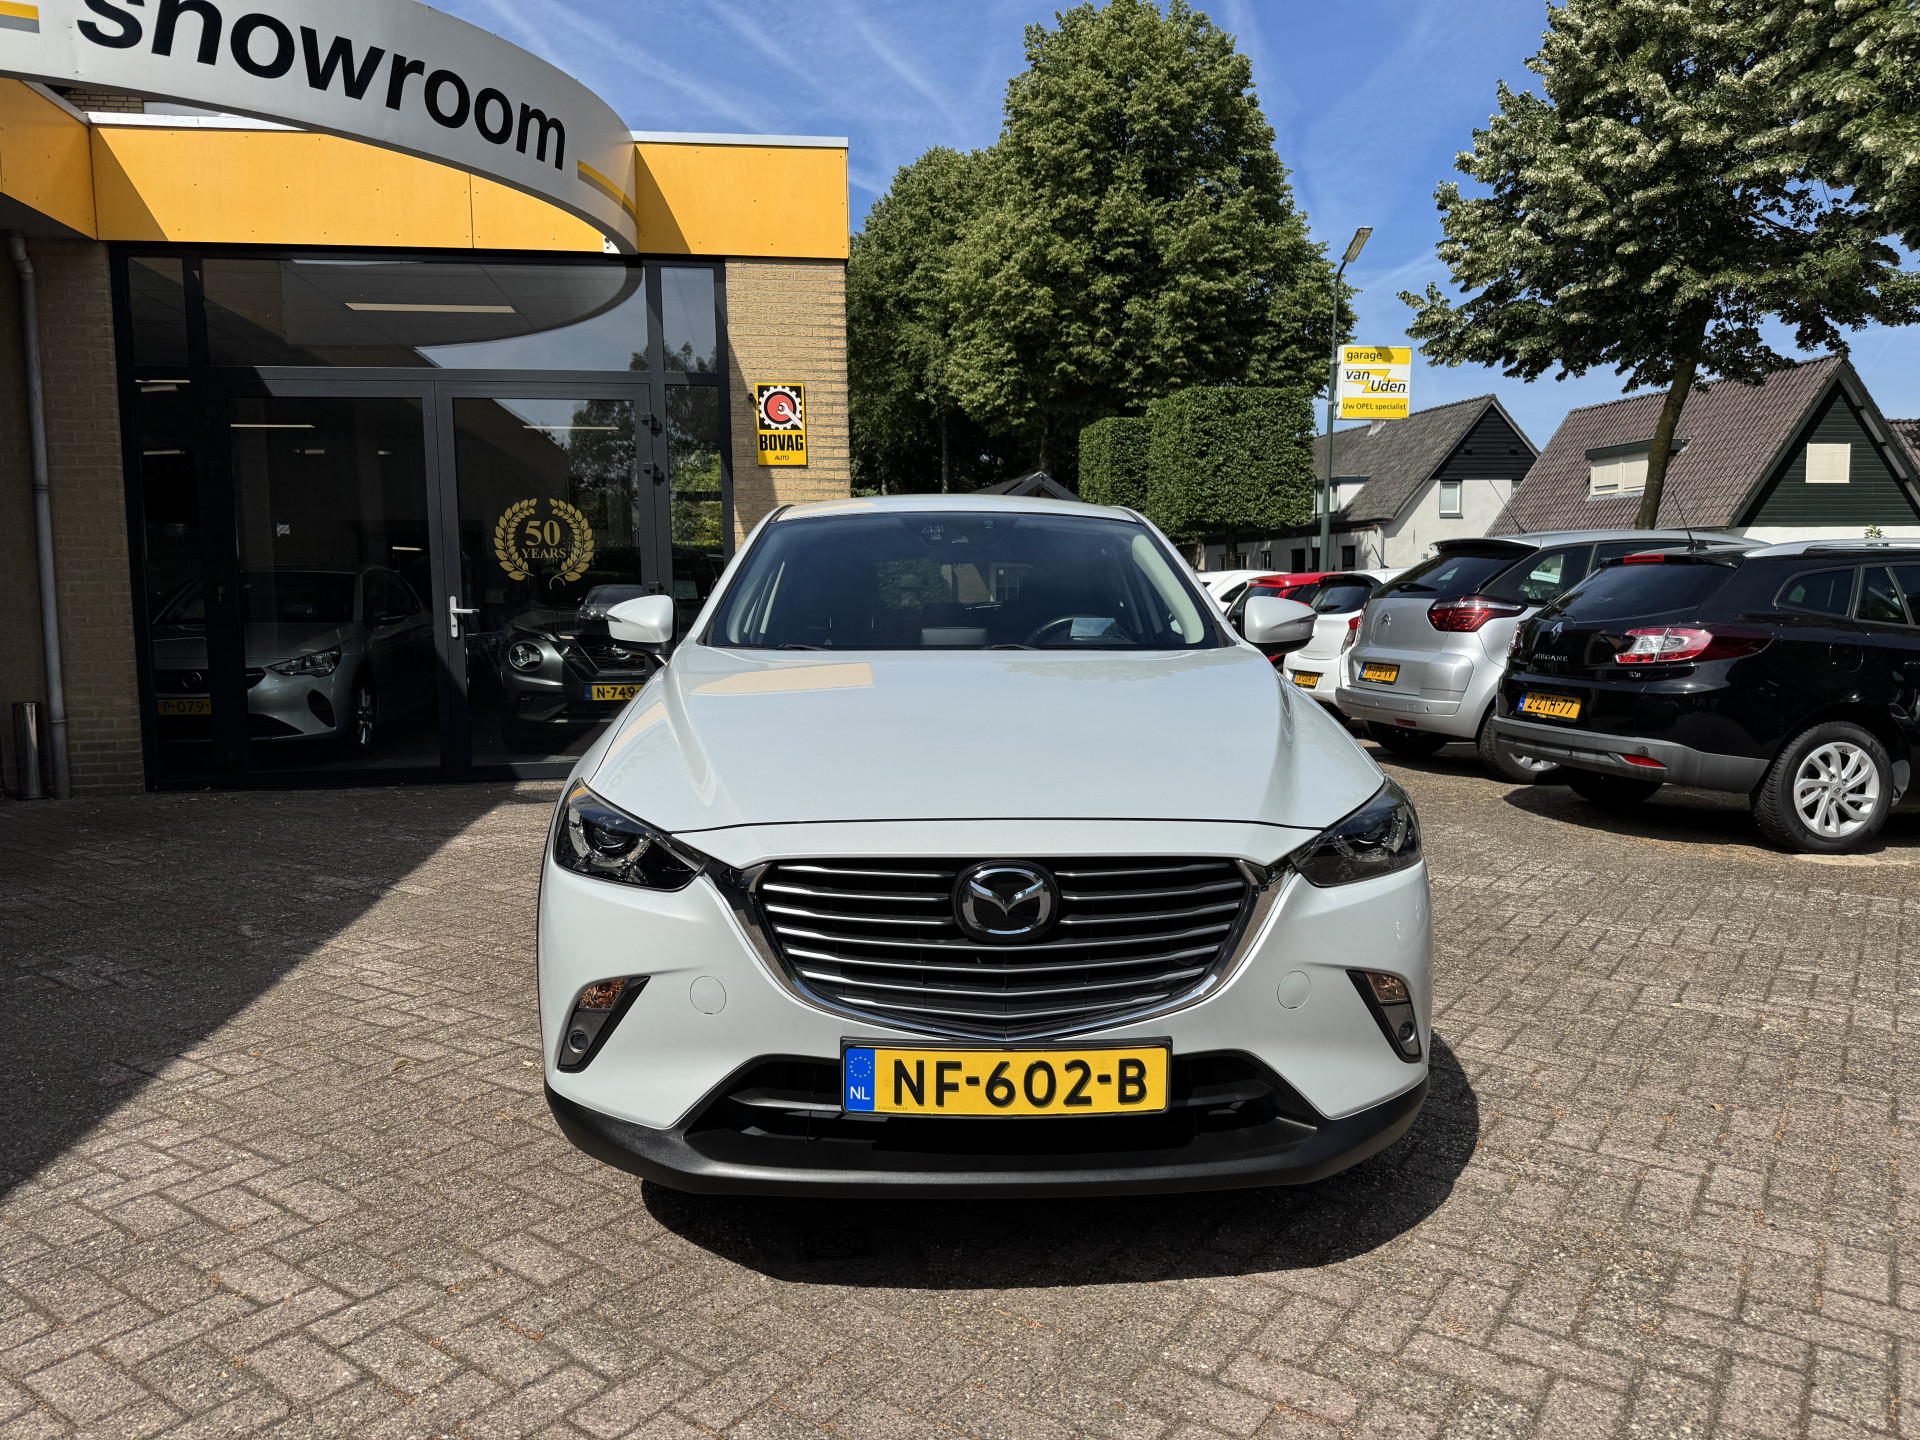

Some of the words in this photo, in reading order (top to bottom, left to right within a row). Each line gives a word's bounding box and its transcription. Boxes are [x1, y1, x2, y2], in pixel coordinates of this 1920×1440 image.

[77, 0, 567, 171] showroom
[1346, 351, 1382, 361] garage
[1346, 370, 1370, 380] van
[1371, 380, 1406, 393] Uden
[1375, 402, 1406, 411] specialist
[759, 434, 804, 451] BOVAG
[525, 520, 561, 546] 50
[521, 548, 567, 559] YEARS
[1527, 695, 1576, 715] 2-ZTH-77
[893, 1058, 1148, 1108] NF-602-B
[850, 1086, 871, 1100] NL
